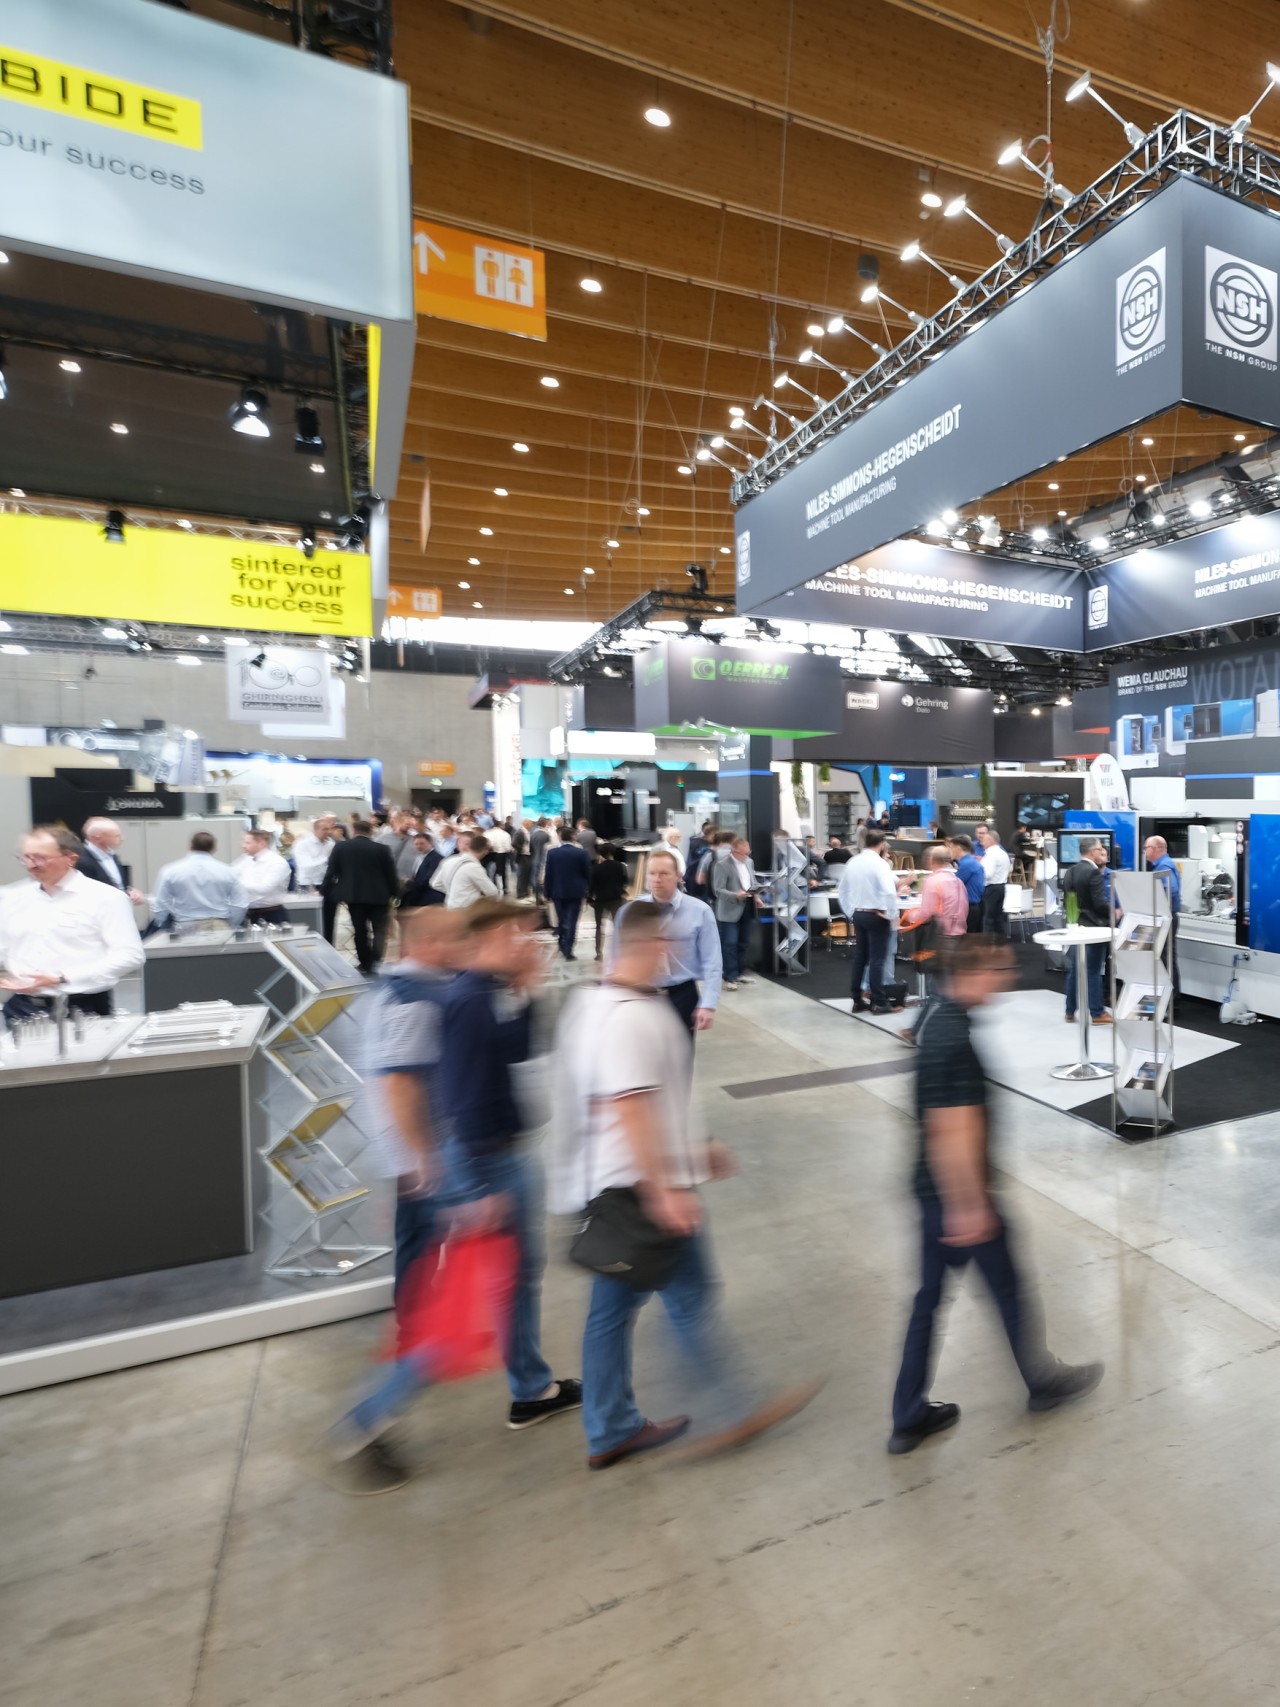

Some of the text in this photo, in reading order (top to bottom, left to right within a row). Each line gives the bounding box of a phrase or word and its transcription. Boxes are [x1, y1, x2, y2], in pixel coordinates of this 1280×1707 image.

[0, 58, 178, 135] BIDE
[0, 129, 205, 195] our success
[1123, 286, 1159, 330] NSH
[1216, 284, 1267, 325] NSH
[1116, 344, 1166, 376] THE NSH GROUP
[1205, 342, 1278, 373] THE NSH GROUP
[805, 403, 962, 521] NILES-SIMMONS-HEGENSCHEIDT
[806, 476, 897, 540] MACHINE TOOL MANUFACTURING
[231, 555, 342, 580] sintered
[238, 573, 345, 598] for your
[804, 579, 989, 612] MACHINE TOOL MANUFACTURING
[825, 564, 1074, 610] ES-SIMMONS-HEGENSCHEIDT
[1195, 582, 1228, 599] MACHINE
[1228, 577, 1249, 591] TOOL
[231, 594, 343, 616] success
[1117, 666, 1188, 688] WEMA GLAUCHAU
[1118, 686, 1135, 696] BRAND
[1136, 685, 1143, 694] OF
[1144, 683, 1154, 693] THE
[1168, 679, 1188, 689] GROUP
[915, 695, 949, 710] Gehring
[310, 775, 364, 786] GESAC
